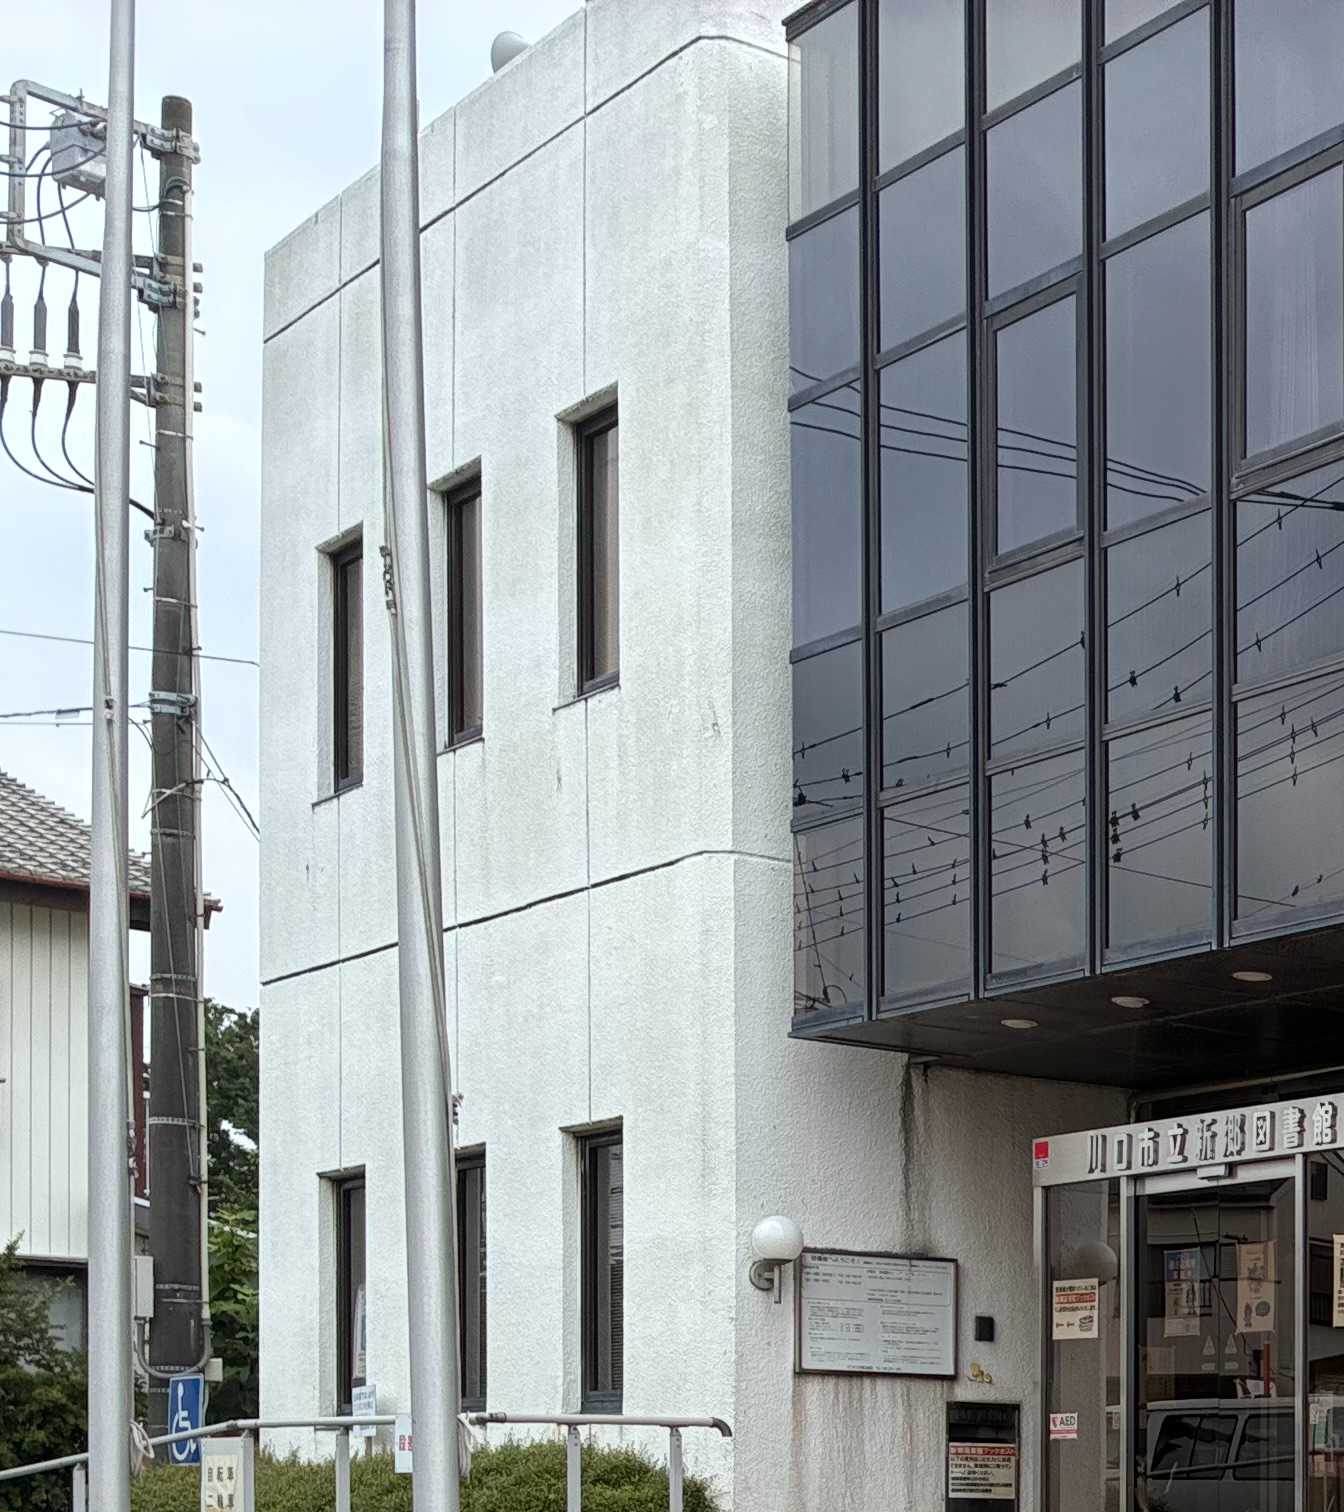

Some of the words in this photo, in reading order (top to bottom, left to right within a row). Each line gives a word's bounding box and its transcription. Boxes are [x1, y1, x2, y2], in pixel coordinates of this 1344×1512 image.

[1088, 1101, 1338, 1176] 川口市立新郷図書館
[1060, 1416, 1076, 1426] AED
